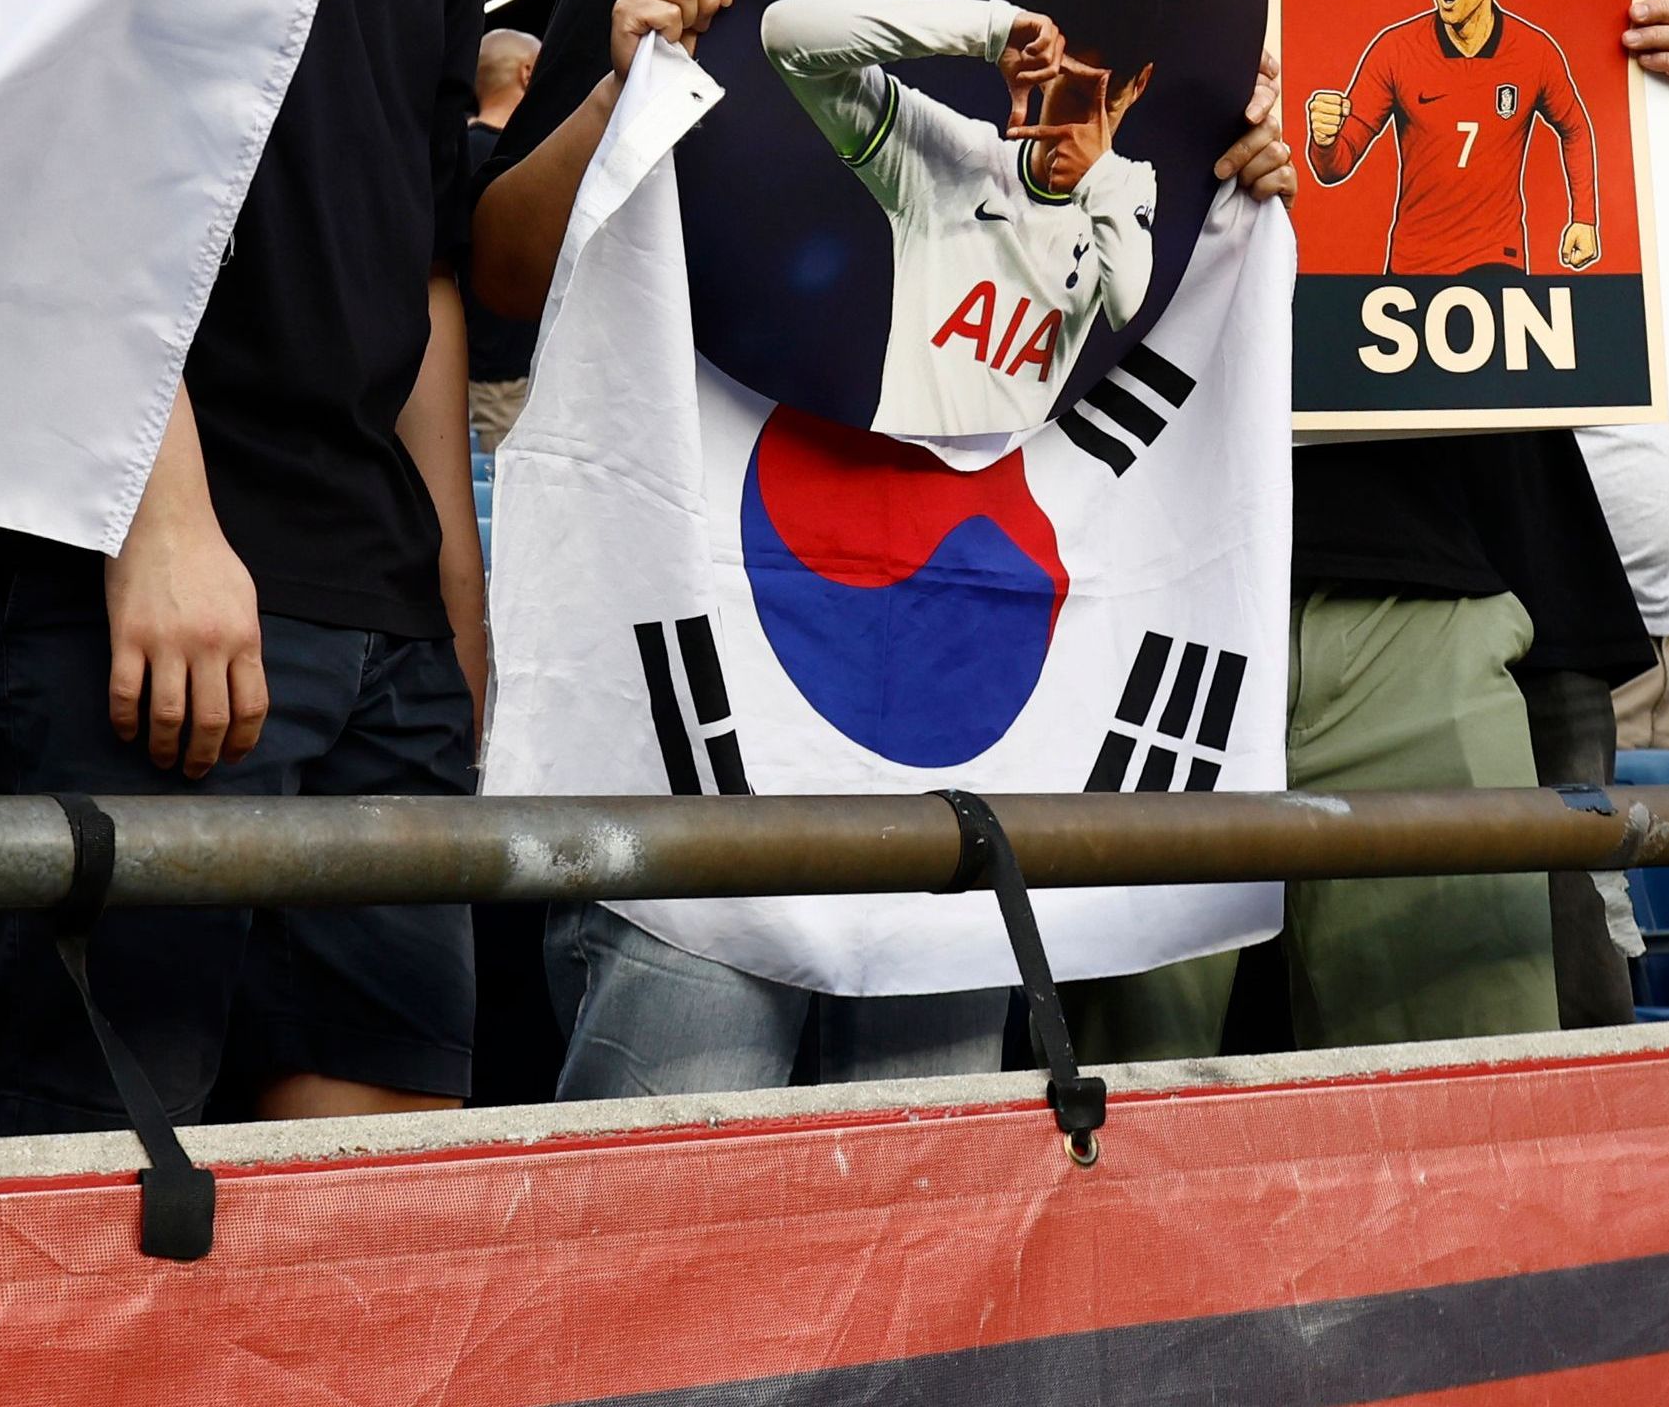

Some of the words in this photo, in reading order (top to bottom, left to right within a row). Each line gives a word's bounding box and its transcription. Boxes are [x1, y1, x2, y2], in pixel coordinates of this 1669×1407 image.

[1457, 121, 1480, 169] 7
[930, 280, 1063, 382] AIA
[1358, 285, 1577, 374] SON
